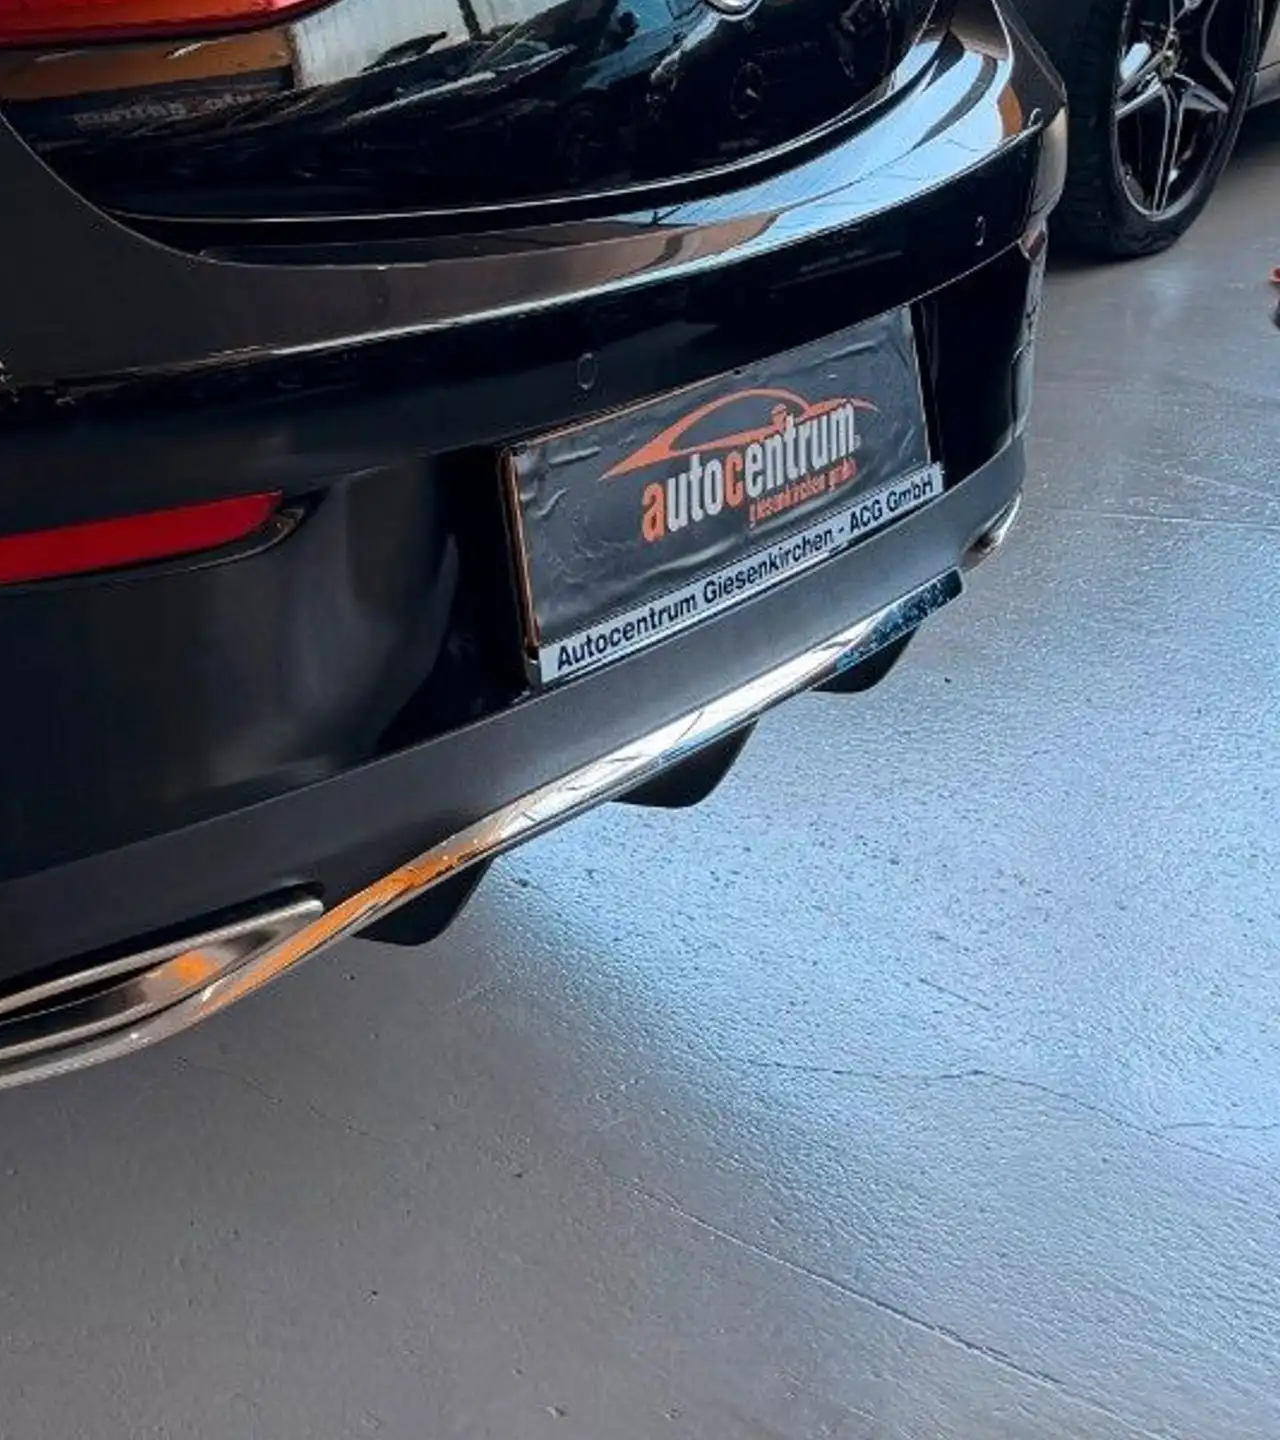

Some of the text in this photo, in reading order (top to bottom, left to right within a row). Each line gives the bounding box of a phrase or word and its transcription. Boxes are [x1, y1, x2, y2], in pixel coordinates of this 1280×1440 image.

[642, 403, 854, 542] autocentrum
[557, 594, 698, 671] Autocentrum
[703, 529, 834, 603] Giesenkirchen
[850, 504, 884, 534] ACG
[886, 472, 934, 514] GmbH
